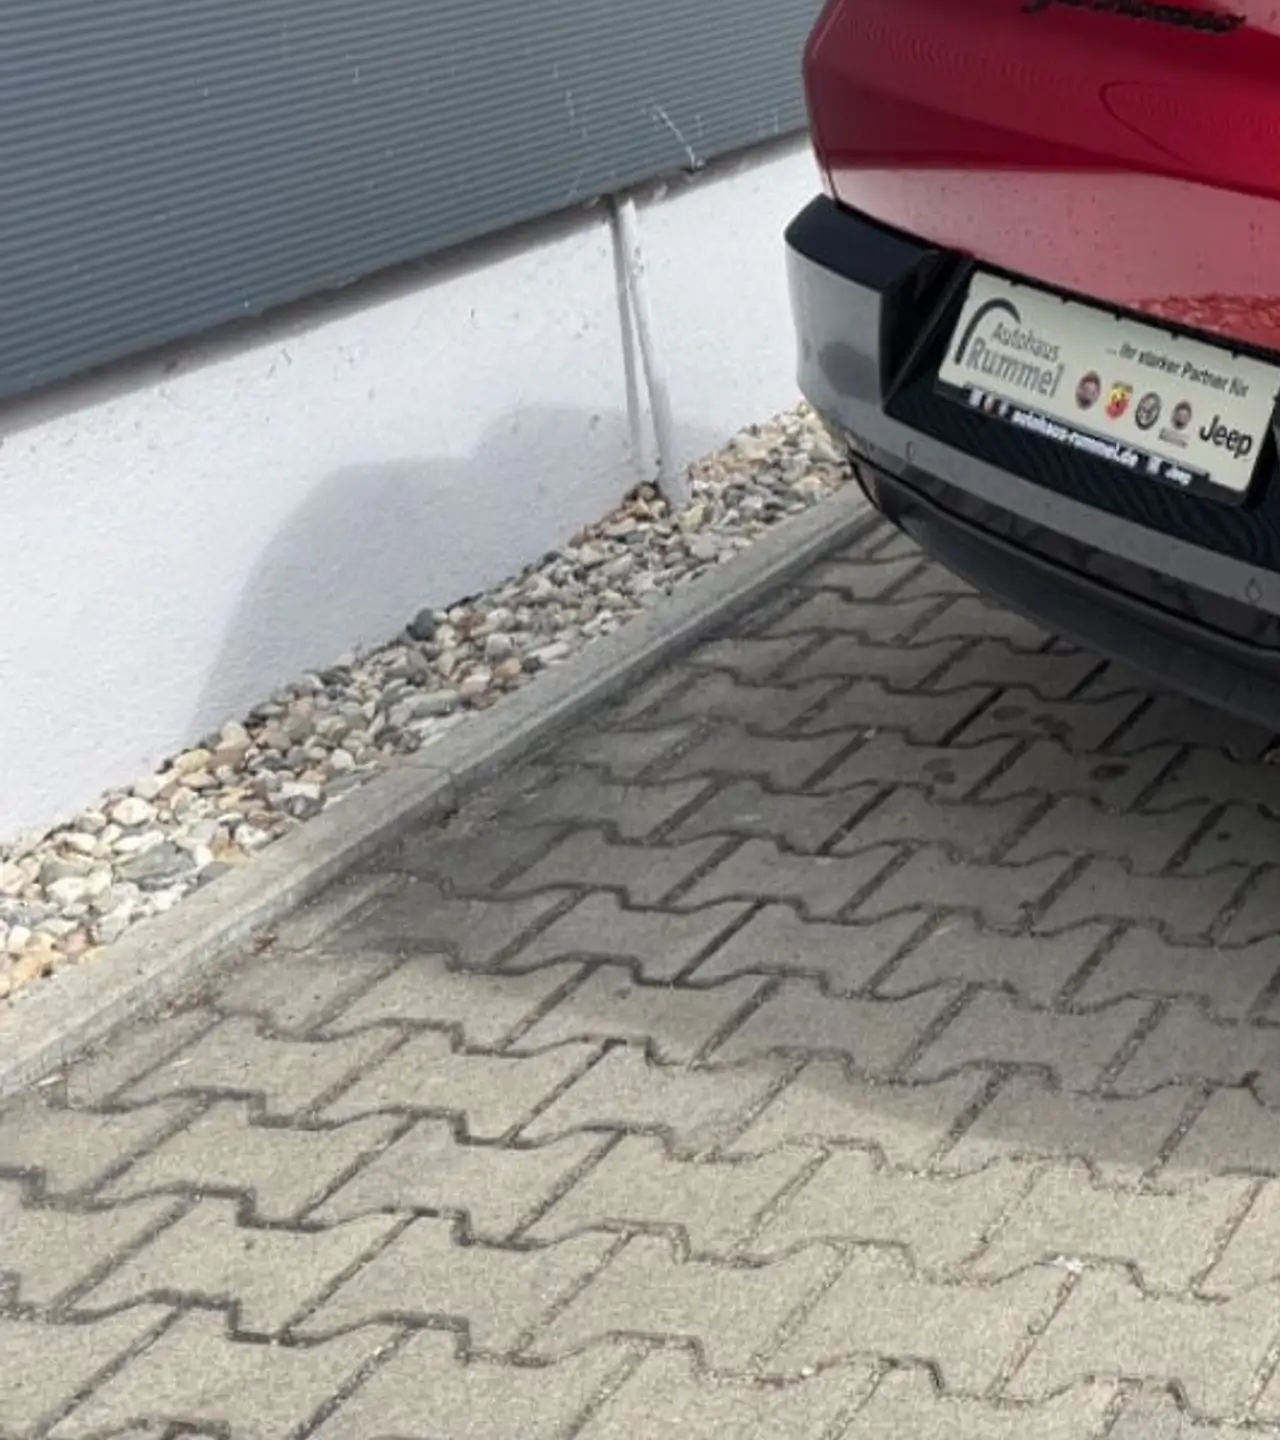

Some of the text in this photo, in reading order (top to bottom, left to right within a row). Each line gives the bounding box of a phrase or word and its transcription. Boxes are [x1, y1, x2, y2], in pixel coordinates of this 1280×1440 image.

[991, 322, 1061, 363] Autohaus
[966, 337, 1065, 398] Rummel
[1181, 361, 1229, 392] Partner
[1200, 413, 1253, 459] Jeep
